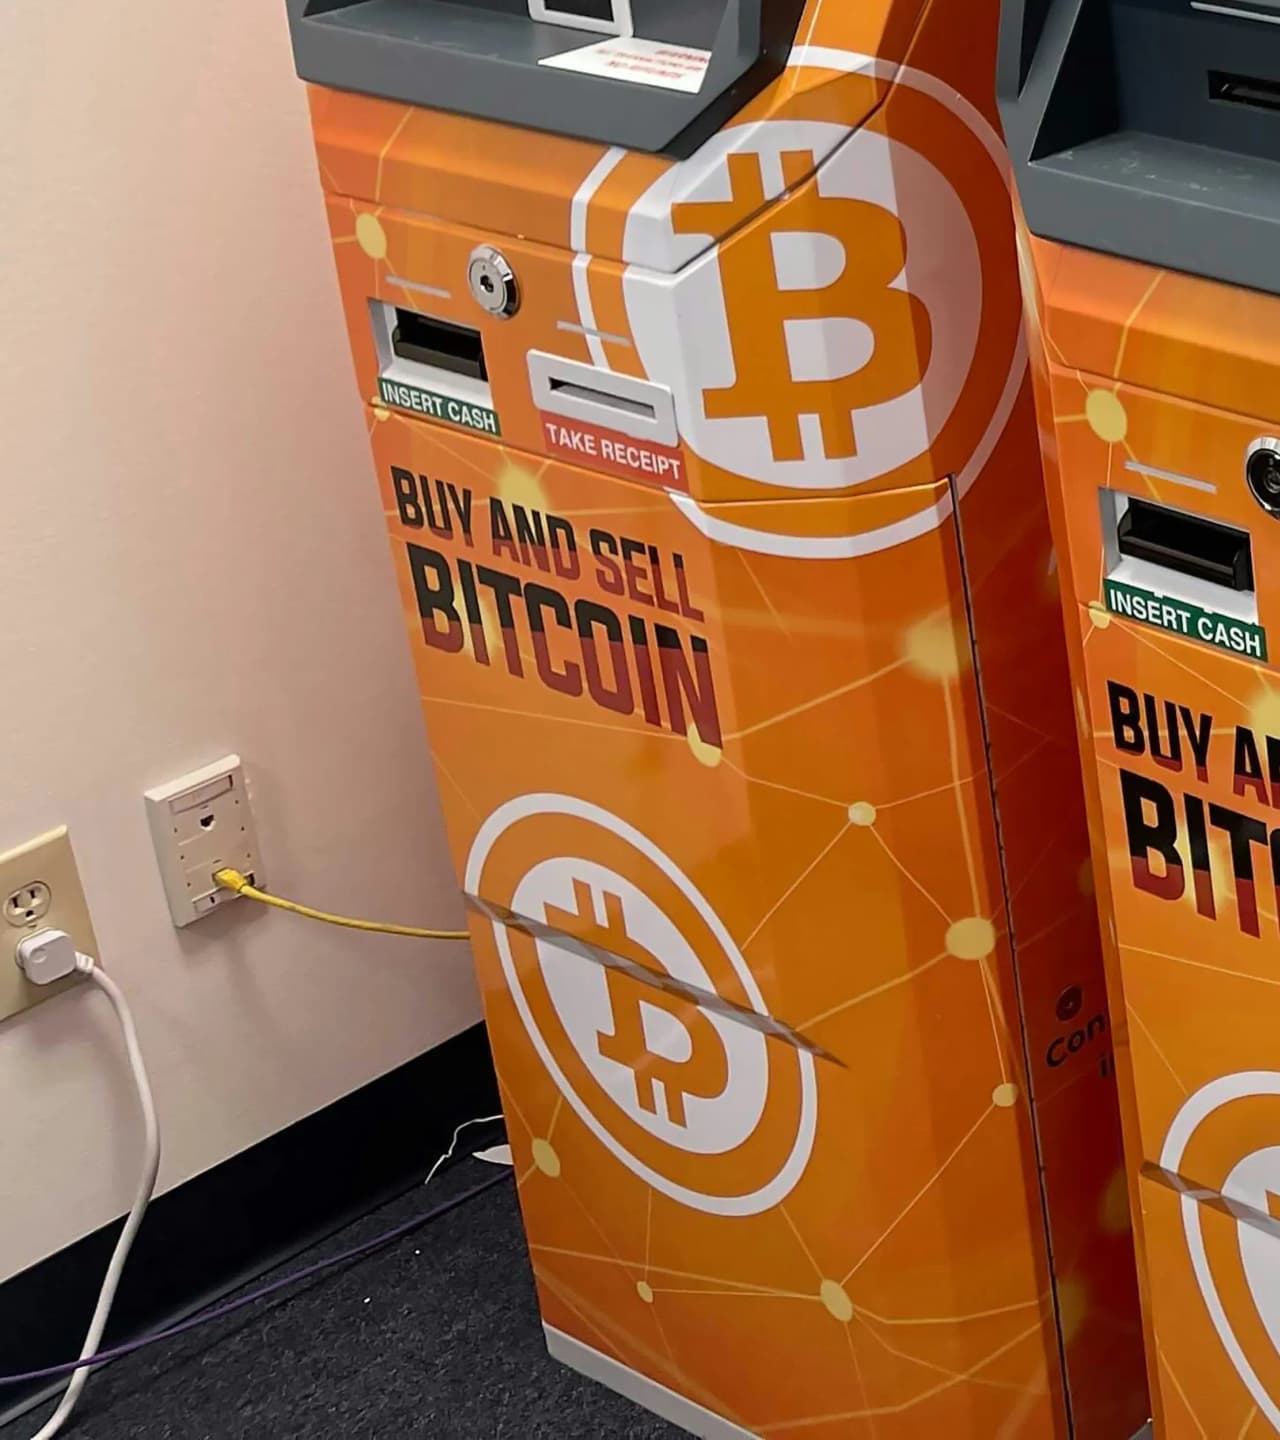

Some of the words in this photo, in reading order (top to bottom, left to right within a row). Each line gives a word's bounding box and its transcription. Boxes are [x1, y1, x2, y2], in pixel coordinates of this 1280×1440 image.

[382, 382, 443, 419] INSERT
[448, 403, 496, 432] CASH
[546, 424, 597, 455] TAKE
[600, 439, 680, 479] RECEIPT
[390, 465, 474, 548] BUY
[489, 496, 581, 581] AND
[589, 529, 705, 623] SELL
[406, 542, 723, 749] BITCOIN
[1110, 589, 1191, 632] INSERT
[1198, 616, 1261, 657] CASH
[1106, 680, 1212, 783] BUY
